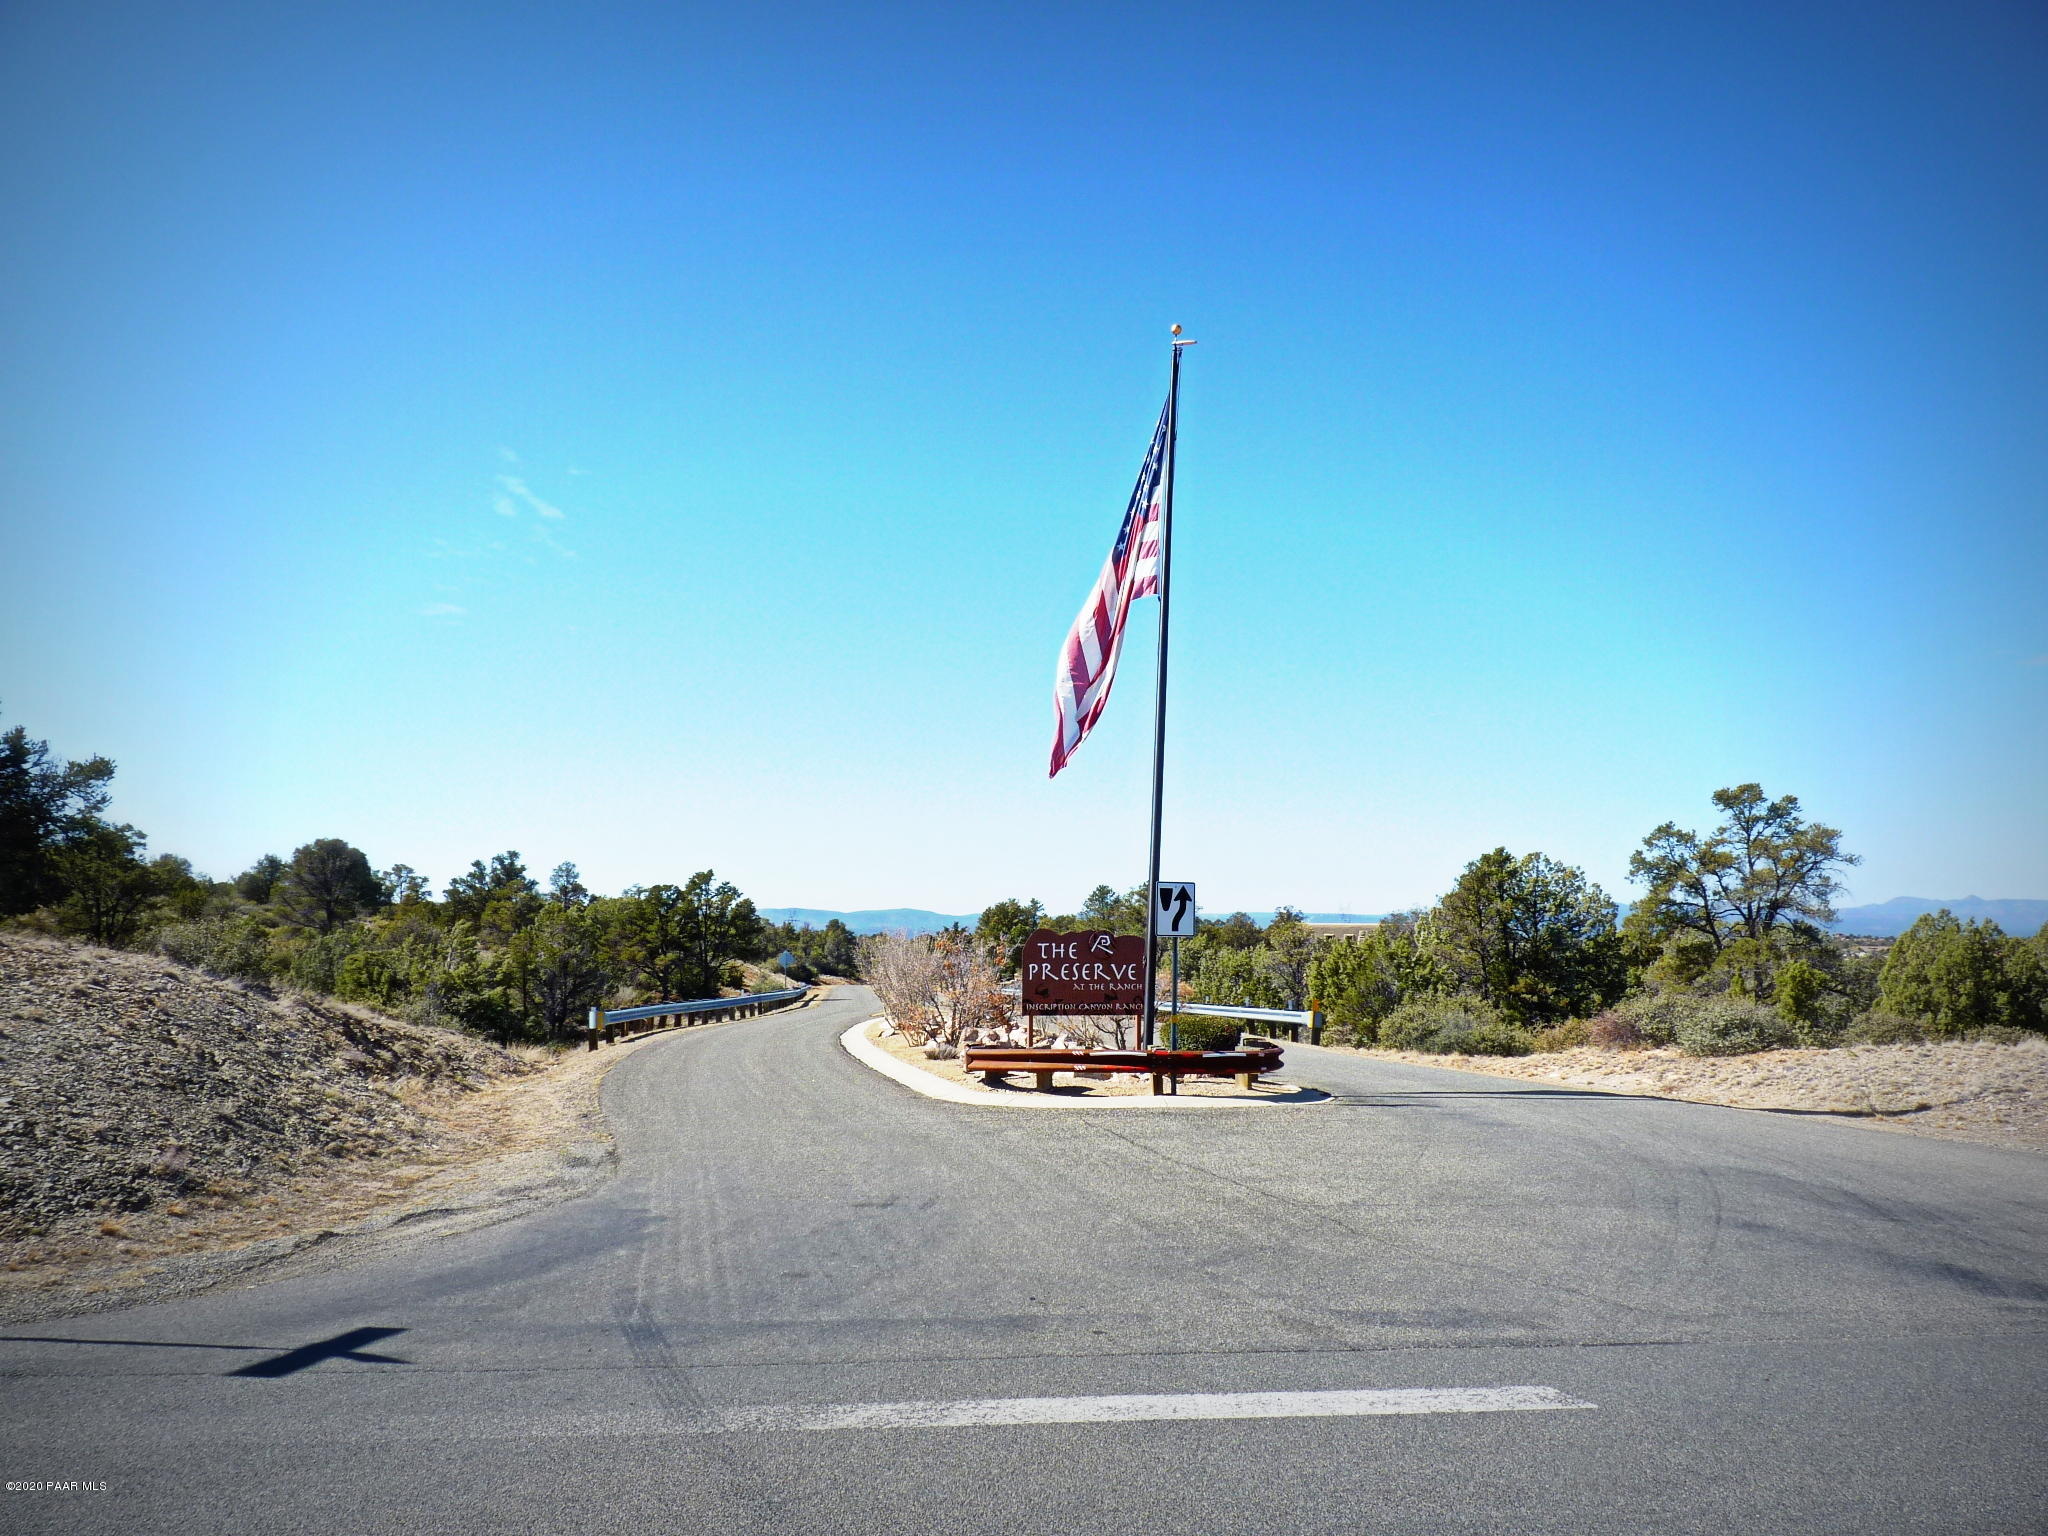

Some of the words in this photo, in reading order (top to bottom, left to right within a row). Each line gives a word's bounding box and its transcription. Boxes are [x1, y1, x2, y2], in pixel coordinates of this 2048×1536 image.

[1037, 942, 1078, 960] THE
[1028, 963, 1137, 981] PRESERVE
[1072, 983, 1085, 991] AT
[1089, 983, 1105, 991] THE
[1109, 983, 1143, 991] RANCH
[1026, 1003, 1076, 1011] INSCRIPTION
[1078, 1003, 1113, 1011] CANYON
